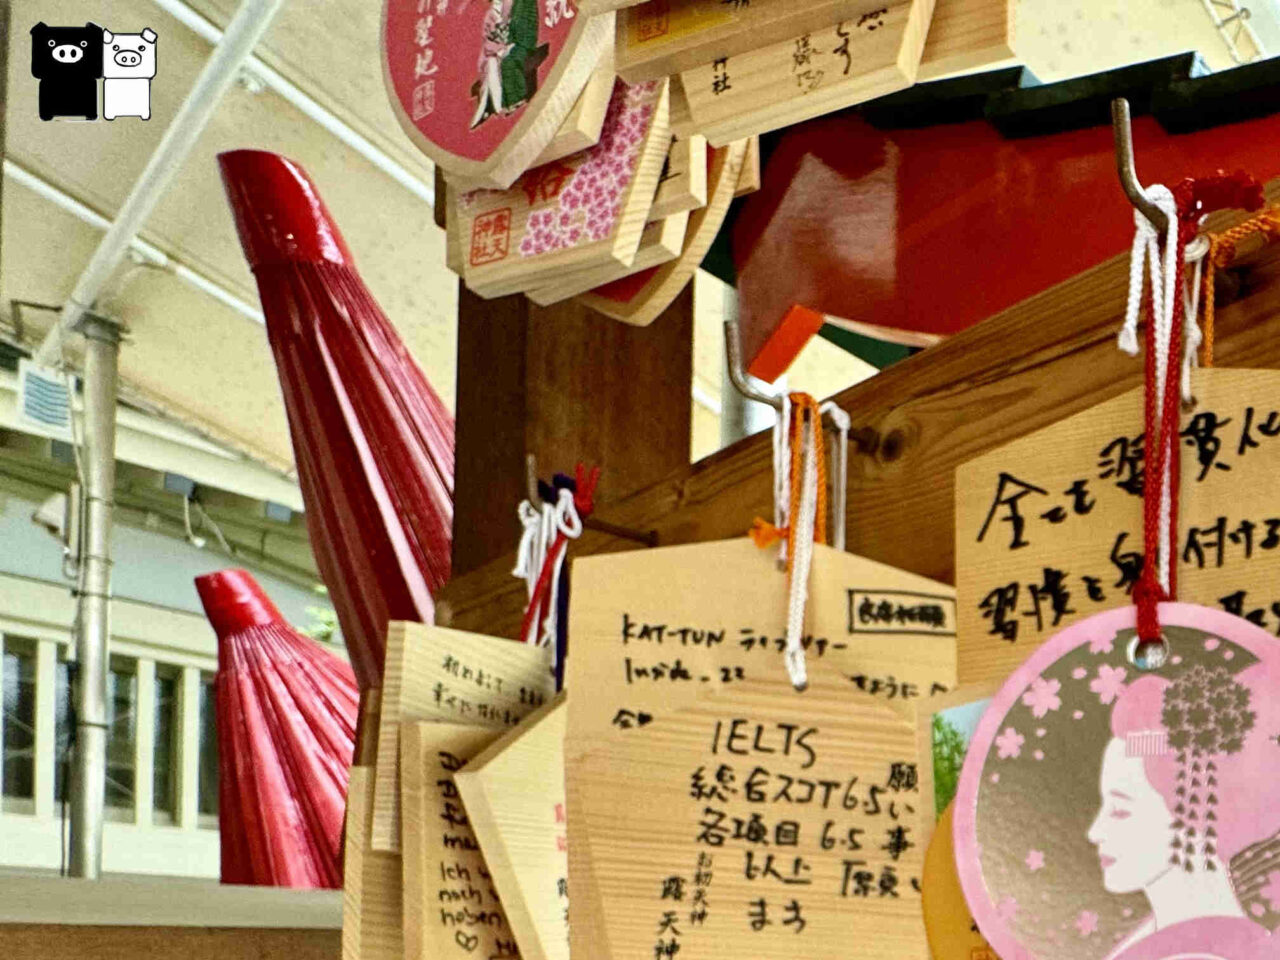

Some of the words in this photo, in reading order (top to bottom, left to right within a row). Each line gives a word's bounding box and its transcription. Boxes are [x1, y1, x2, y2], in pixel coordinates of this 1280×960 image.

[622, 613, 725, 647] KAT-TUN
[711, 718, 818, 770] IELTS
[882, 761, 919, 861] 願い事
